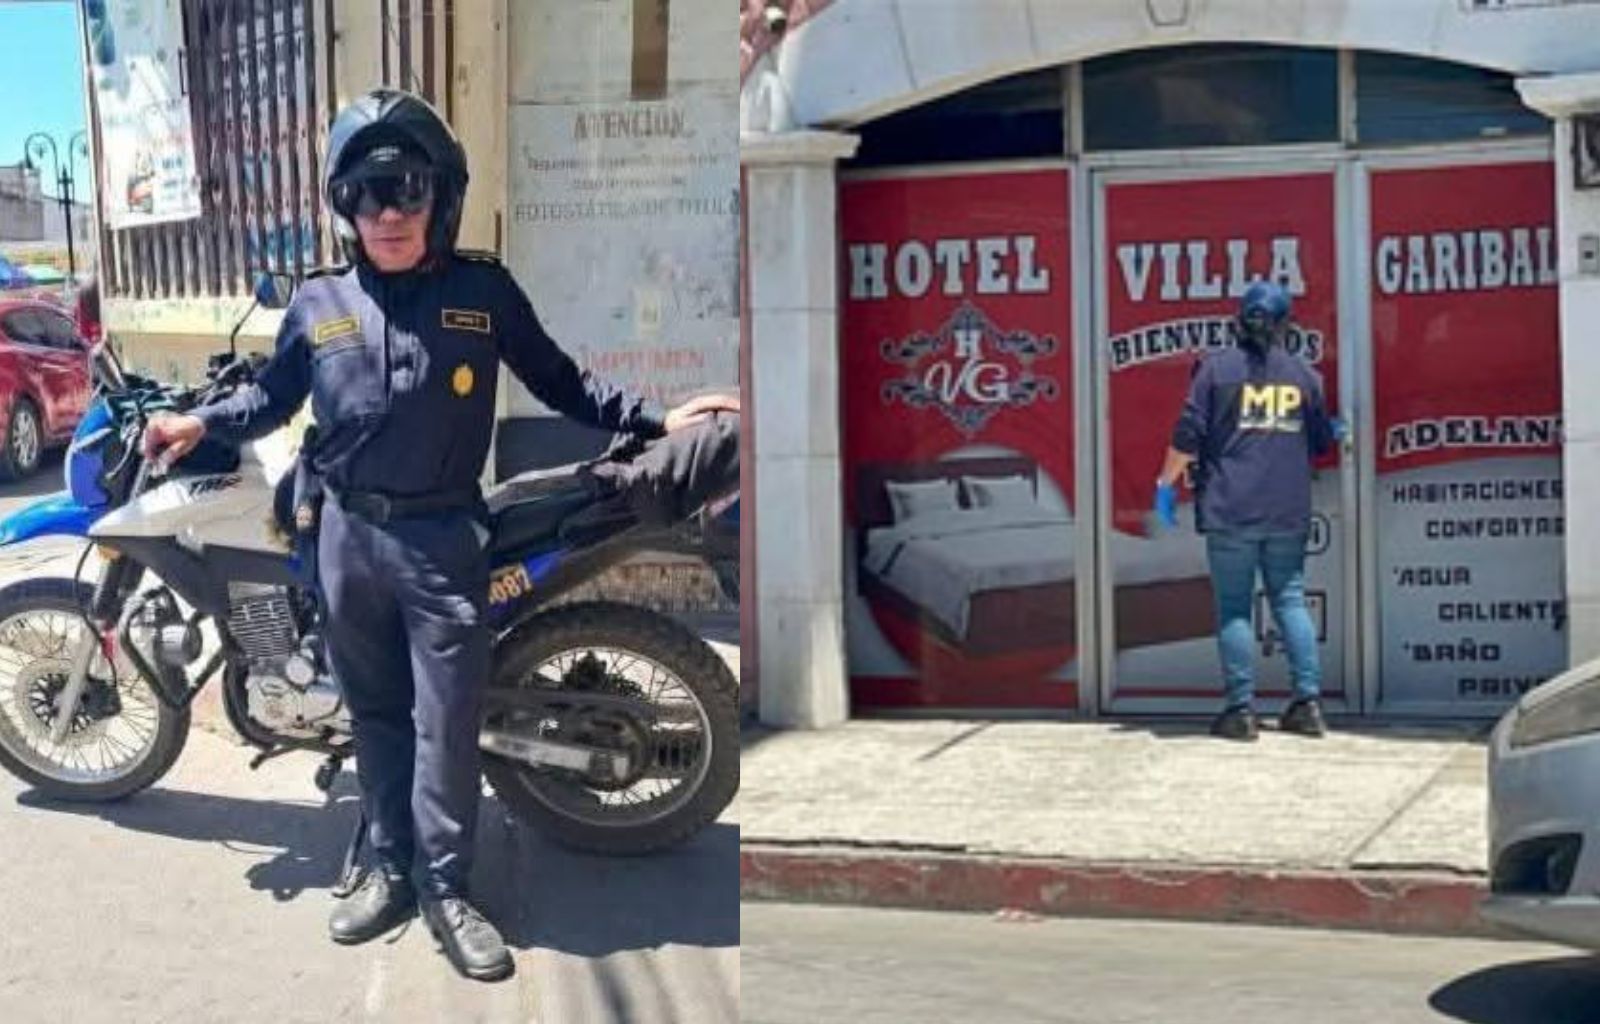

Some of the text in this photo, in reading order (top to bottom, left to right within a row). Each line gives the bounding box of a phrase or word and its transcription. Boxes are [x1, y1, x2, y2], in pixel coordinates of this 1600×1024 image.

[849, 236, 1049, 298] HOTEL
[1117, 238, 1306, 301] VILLA
[1109, 316, 1323, 372] BIENVENOS
[1241, 384, 1301, 417] MP
[1386, 417, 1563, 457] ADELAN
